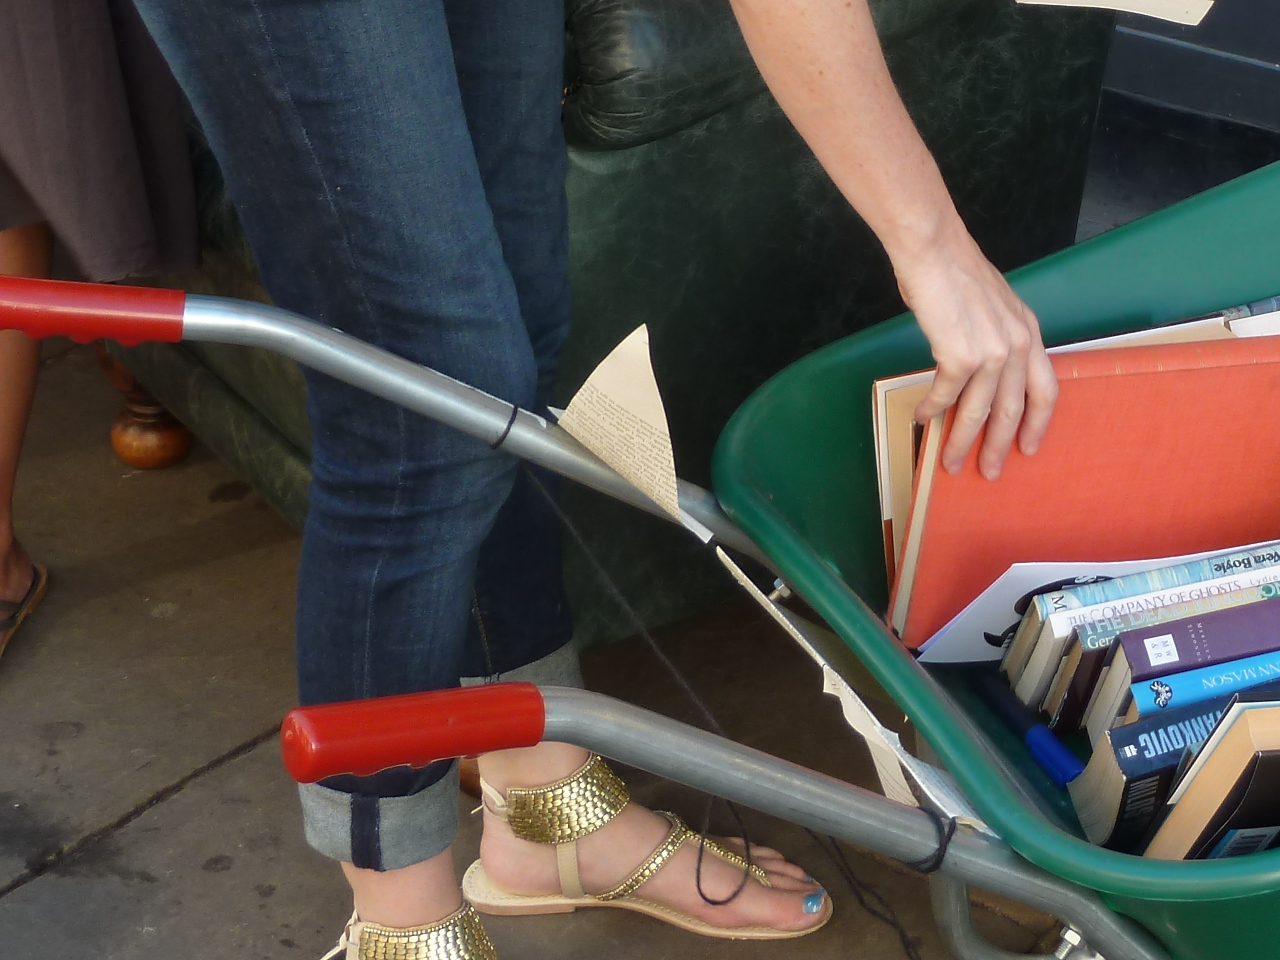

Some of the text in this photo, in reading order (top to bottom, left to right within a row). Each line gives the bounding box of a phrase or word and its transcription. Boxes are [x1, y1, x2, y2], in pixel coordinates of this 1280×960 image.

[1213, 555, 1252, 574] Boyle
[1049, 593, 1070, 612] M
[1067, 612, 1088, 627] THE
[1088, 594, 1167, 623] COMPANY
[1169, 588, 1187, 605] OF
[1188, 580, 1242, 603] GHOSTS
[1249, 571, 1279, 588] Lydie
[1083, 611, 1127, 635] THE
[1129, 602, 1186, 627] DEAD
[1161, 639, 1172, 657] M W
[1202, 667, 1256, 688] MASON
